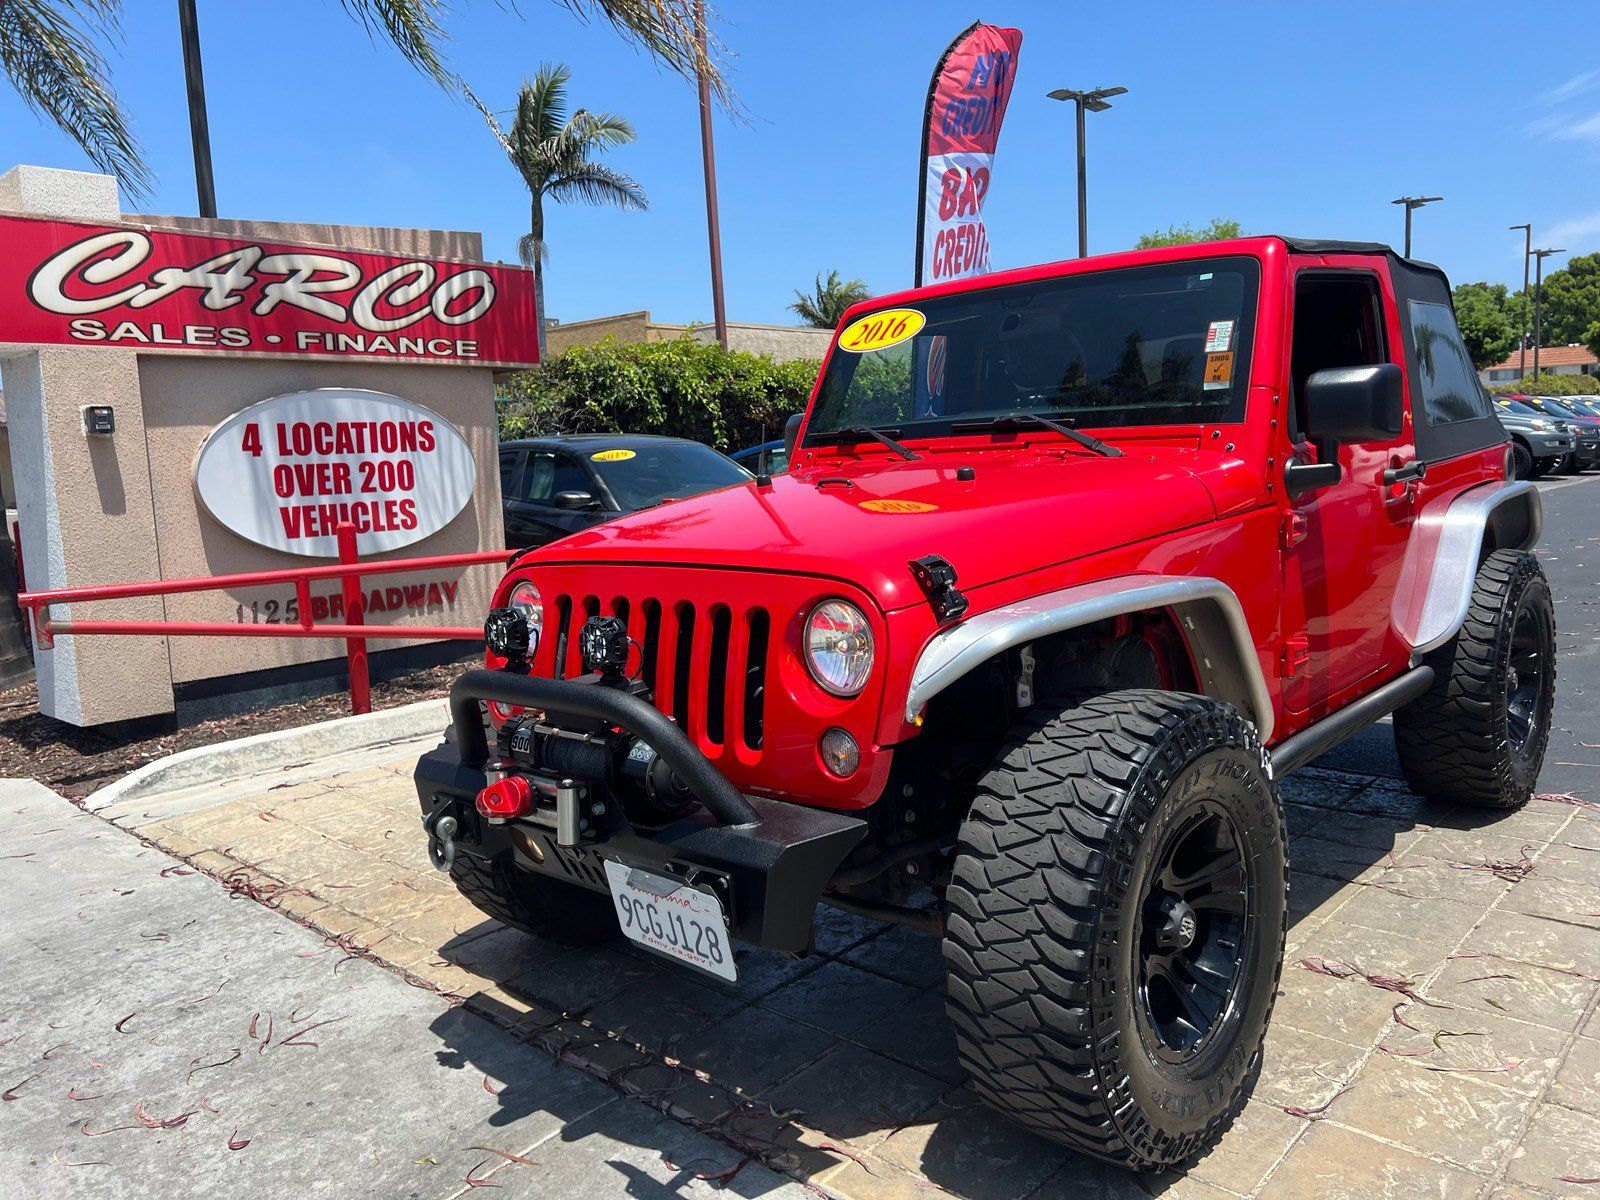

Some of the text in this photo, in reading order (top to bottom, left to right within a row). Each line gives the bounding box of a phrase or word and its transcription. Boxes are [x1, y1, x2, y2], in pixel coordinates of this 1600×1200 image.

[30, 232, 496, 331] CARCO
[70, 318, 480, 358] SALES FINANCE
[849, 314, 912, 347] 2016
[1210, 354, 1230, 363] SMOG
[241, 420, 436, 457] 4 LOCATIONS
[273, 459, 415, 498] OVER 200
[236, 598, 299, 624] 1125
[619, 893, 724, 965] 9CGJ128
